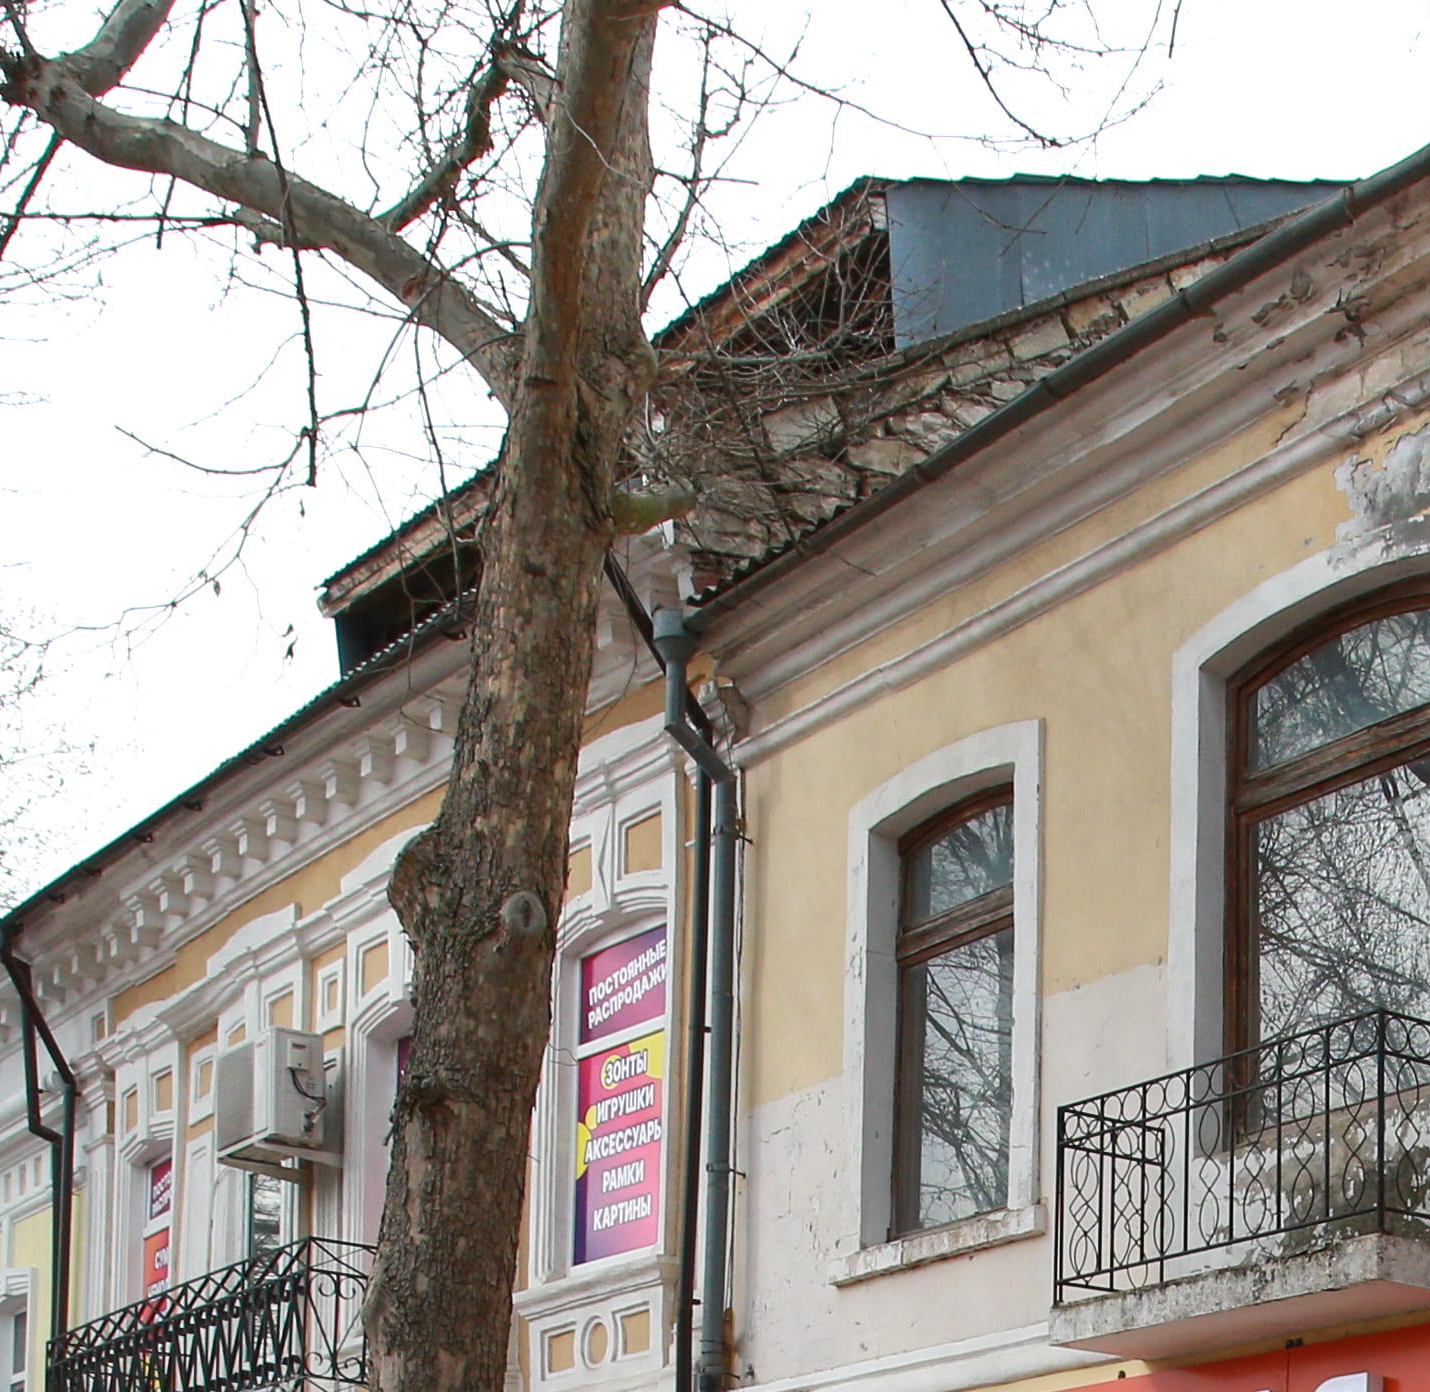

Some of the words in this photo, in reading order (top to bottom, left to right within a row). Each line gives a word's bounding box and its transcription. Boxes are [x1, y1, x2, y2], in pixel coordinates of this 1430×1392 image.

[589, 939, 666, 1006] ПОСТОЯННЫЕ
[605, 1049, 647, 1085] ЗОНТЫ
[597, 1083, 655, 1125] ИГРУШКИ
[602, 1160, 644, 1194] РАМКИ
[593, 1194, 651, 1232] КАРТИНЫ
